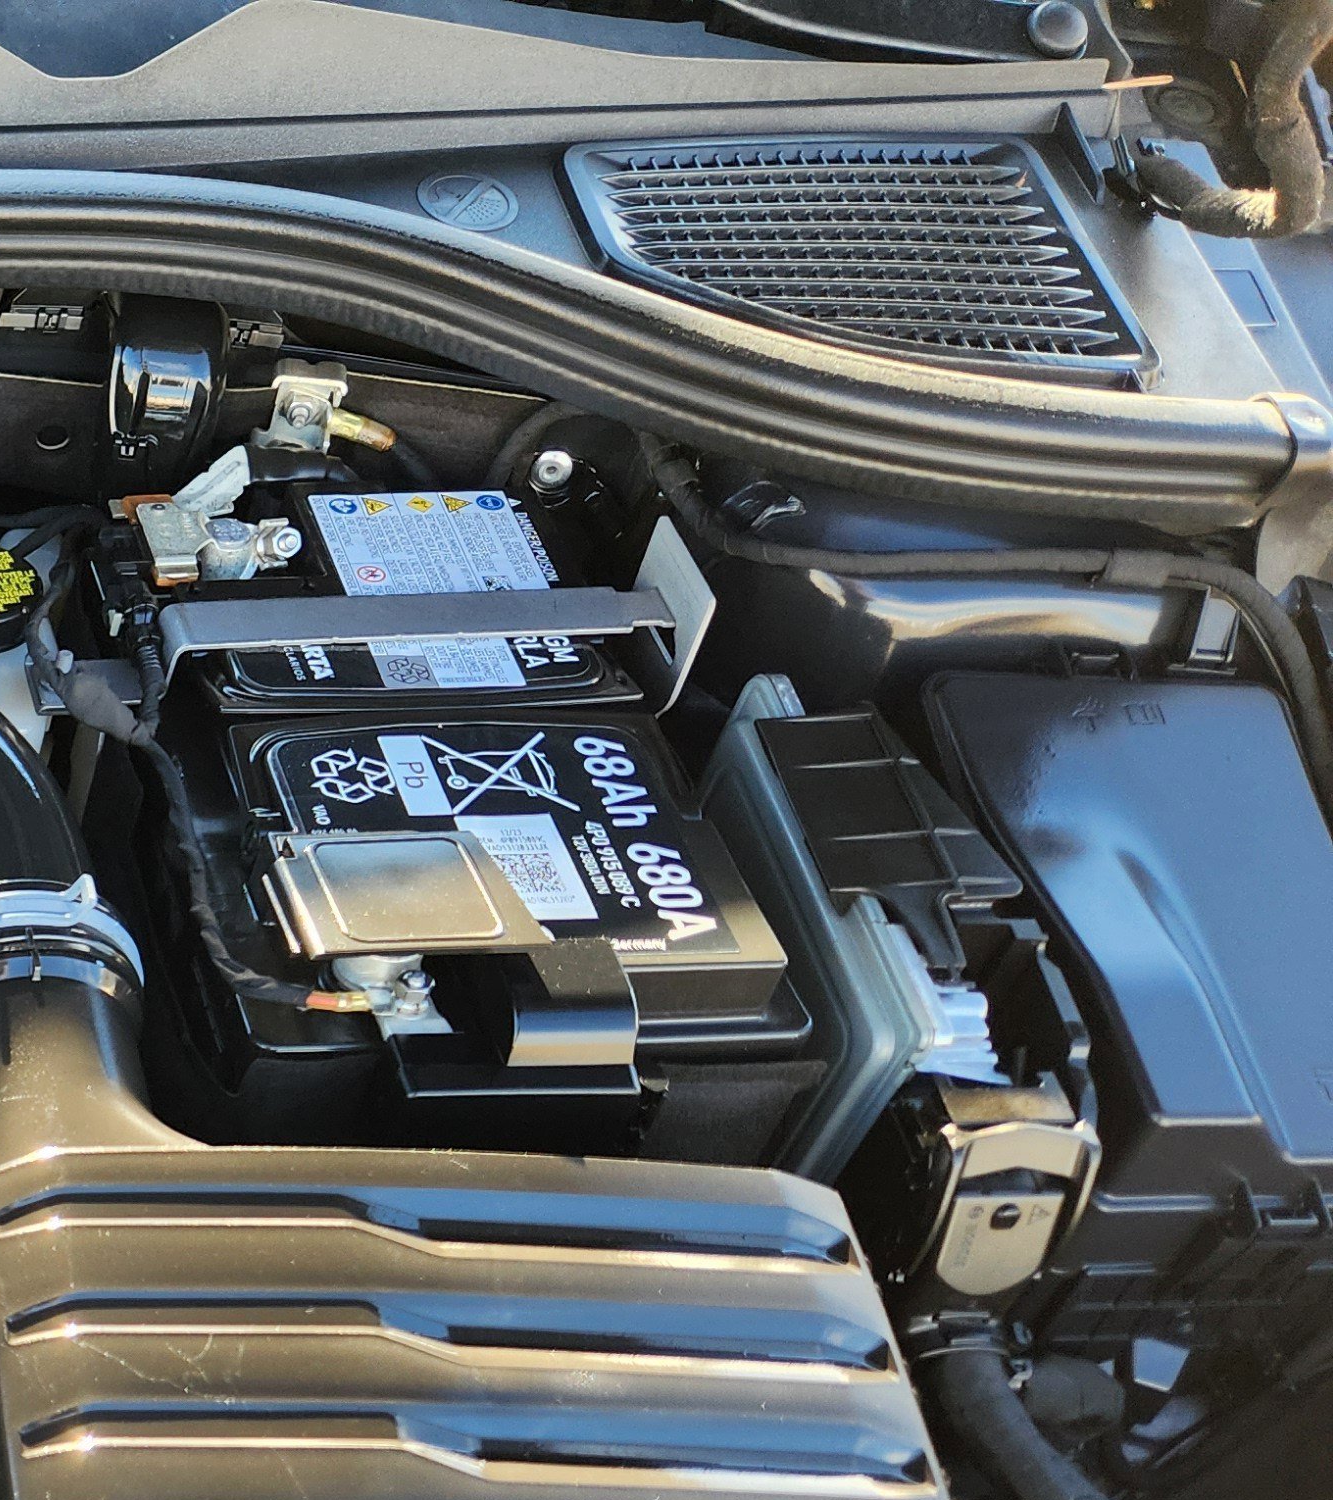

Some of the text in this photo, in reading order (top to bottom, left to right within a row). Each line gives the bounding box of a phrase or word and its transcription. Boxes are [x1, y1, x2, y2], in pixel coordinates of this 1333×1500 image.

[514, 511, 559, 581] DANGER/POISON
[300, 645, 335, 681] RTA
[513, 637, 549, 668] RLA
[543, 636, 579, 663] GM
[284, 646, 307, 683] CLARIOS
[397, 761, 430, 789] Pb
[573, 736, 718, 943] 68Ah 680A
[594, 847, 622, 870] 915
[607, 871, 635, 894] 089
[618, 896, 642, 908] C
